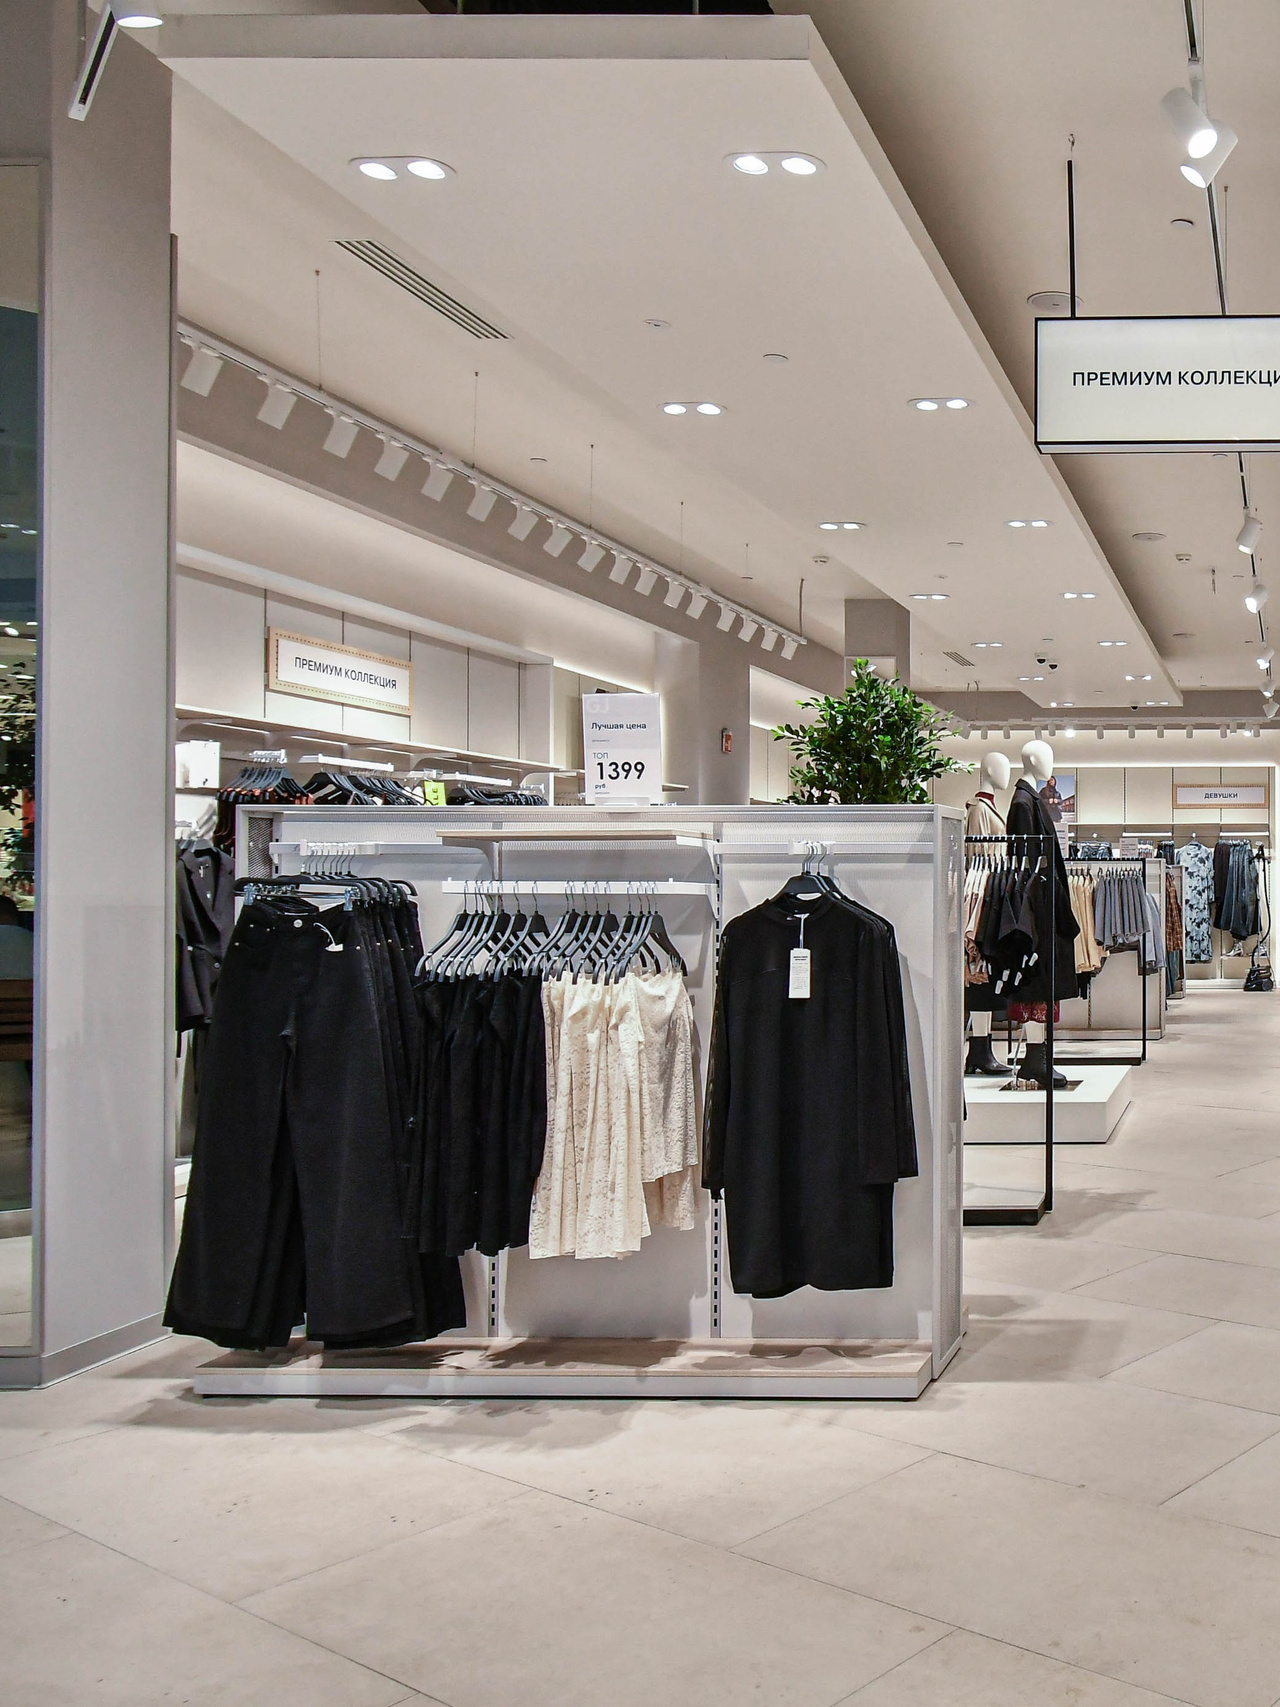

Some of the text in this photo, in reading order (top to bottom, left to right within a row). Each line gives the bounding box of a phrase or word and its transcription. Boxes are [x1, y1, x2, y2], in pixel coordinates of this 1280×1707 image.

[1072, 370, 1172, 386] ПРЕМИУМ
[294, 656, 397, 690] ПРЕМИУМ КОЛЛЕКЦИЯ
[591, 722, 647, 731] Лучшая цена
[596, 761, 646, 780] 1399
[1204, 792, 1238, 800] ДЕВУШКИ
